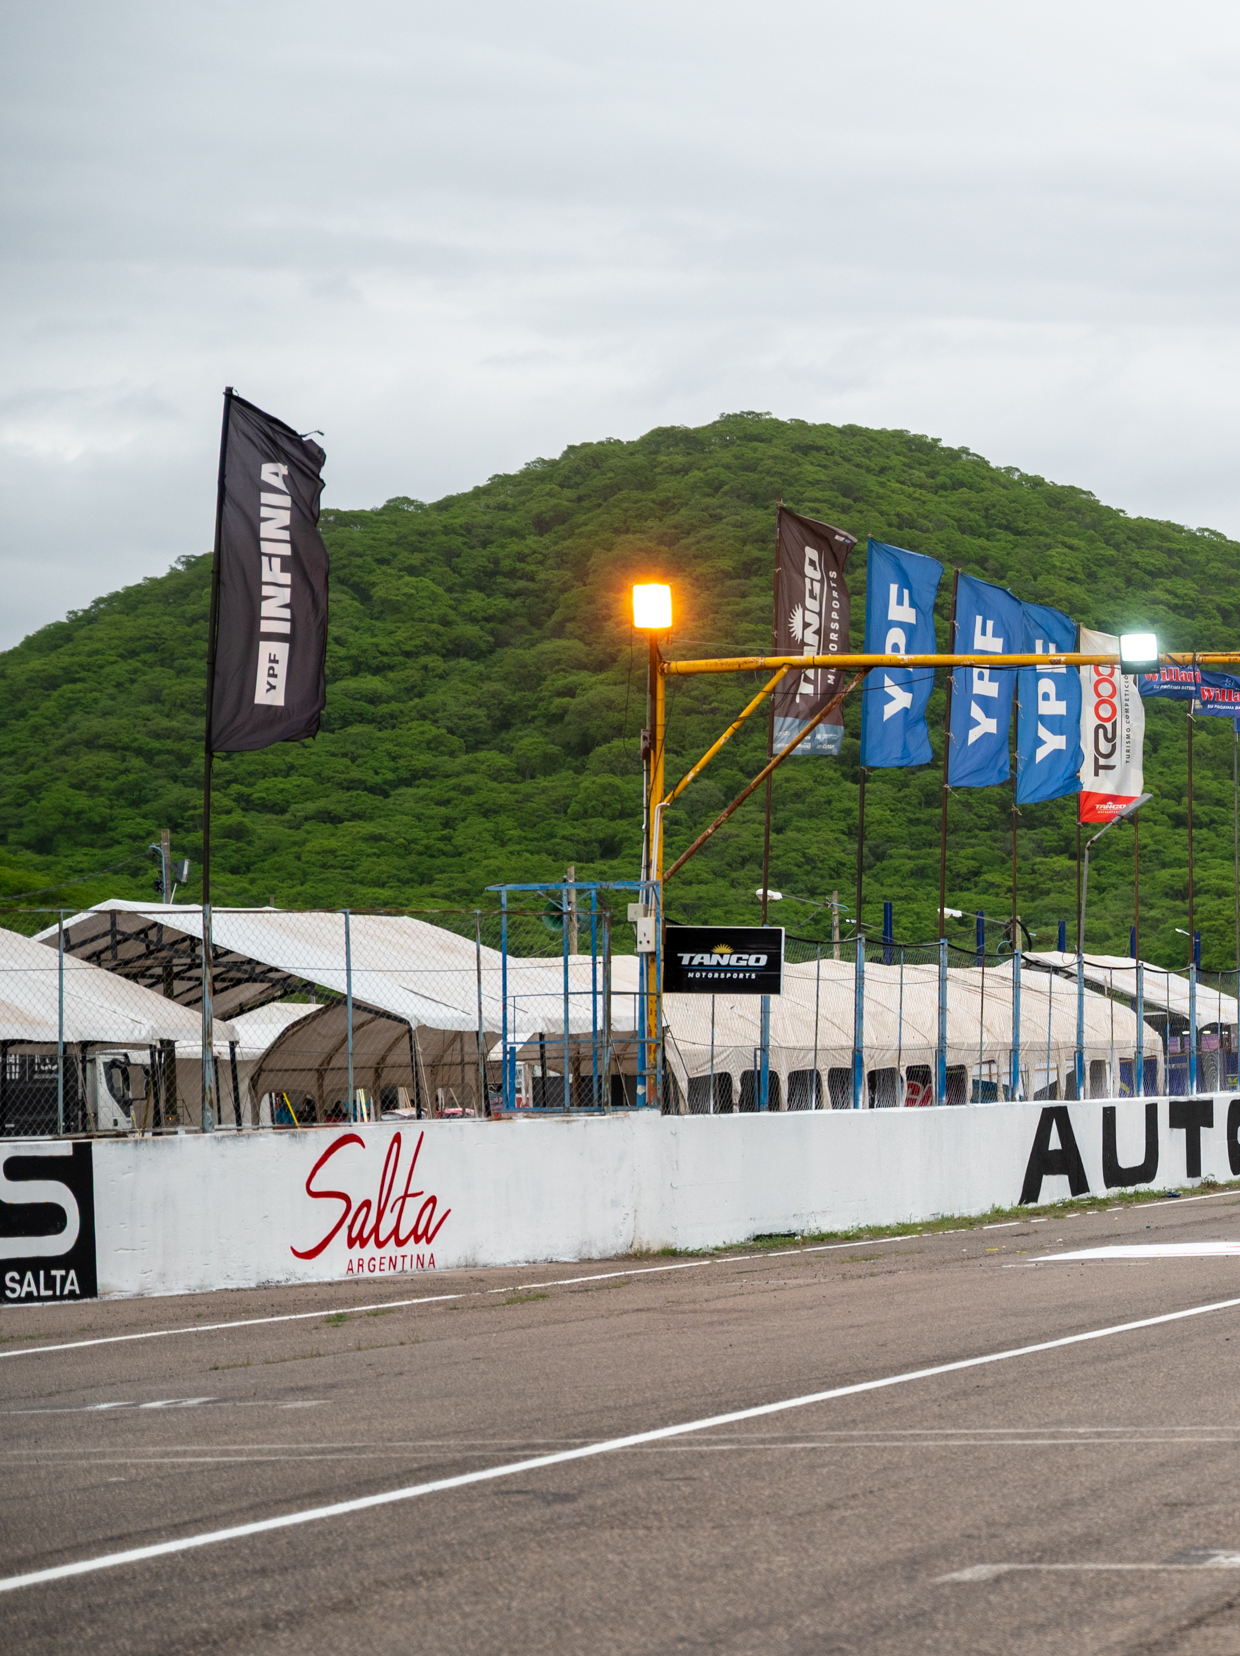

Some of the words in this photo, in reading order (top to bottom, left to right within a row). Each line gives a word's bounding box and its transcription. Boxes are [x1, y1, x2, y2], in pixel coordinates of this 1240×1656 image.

[260, 462, 292, 634] INFINIA
[265, 652, 280, 694] YPF
[795, 546, 821, 703] TANGO
[828, 570, 840, 685] MORSPORTS
[883, 583, 917, 722] YPF
[968, 615, 1004, 746] YPF
[1036, 639, 1067, 764] YPF
[677, 953, 768, 967] TANGO
[687, 972, 756, 980] MOTORSPORTS
[290, 1130, 452, 1260] Salta
[4, 1269, 80, 1299] SALTA
[346, 1253, 436, 1275] ARGENTINA
